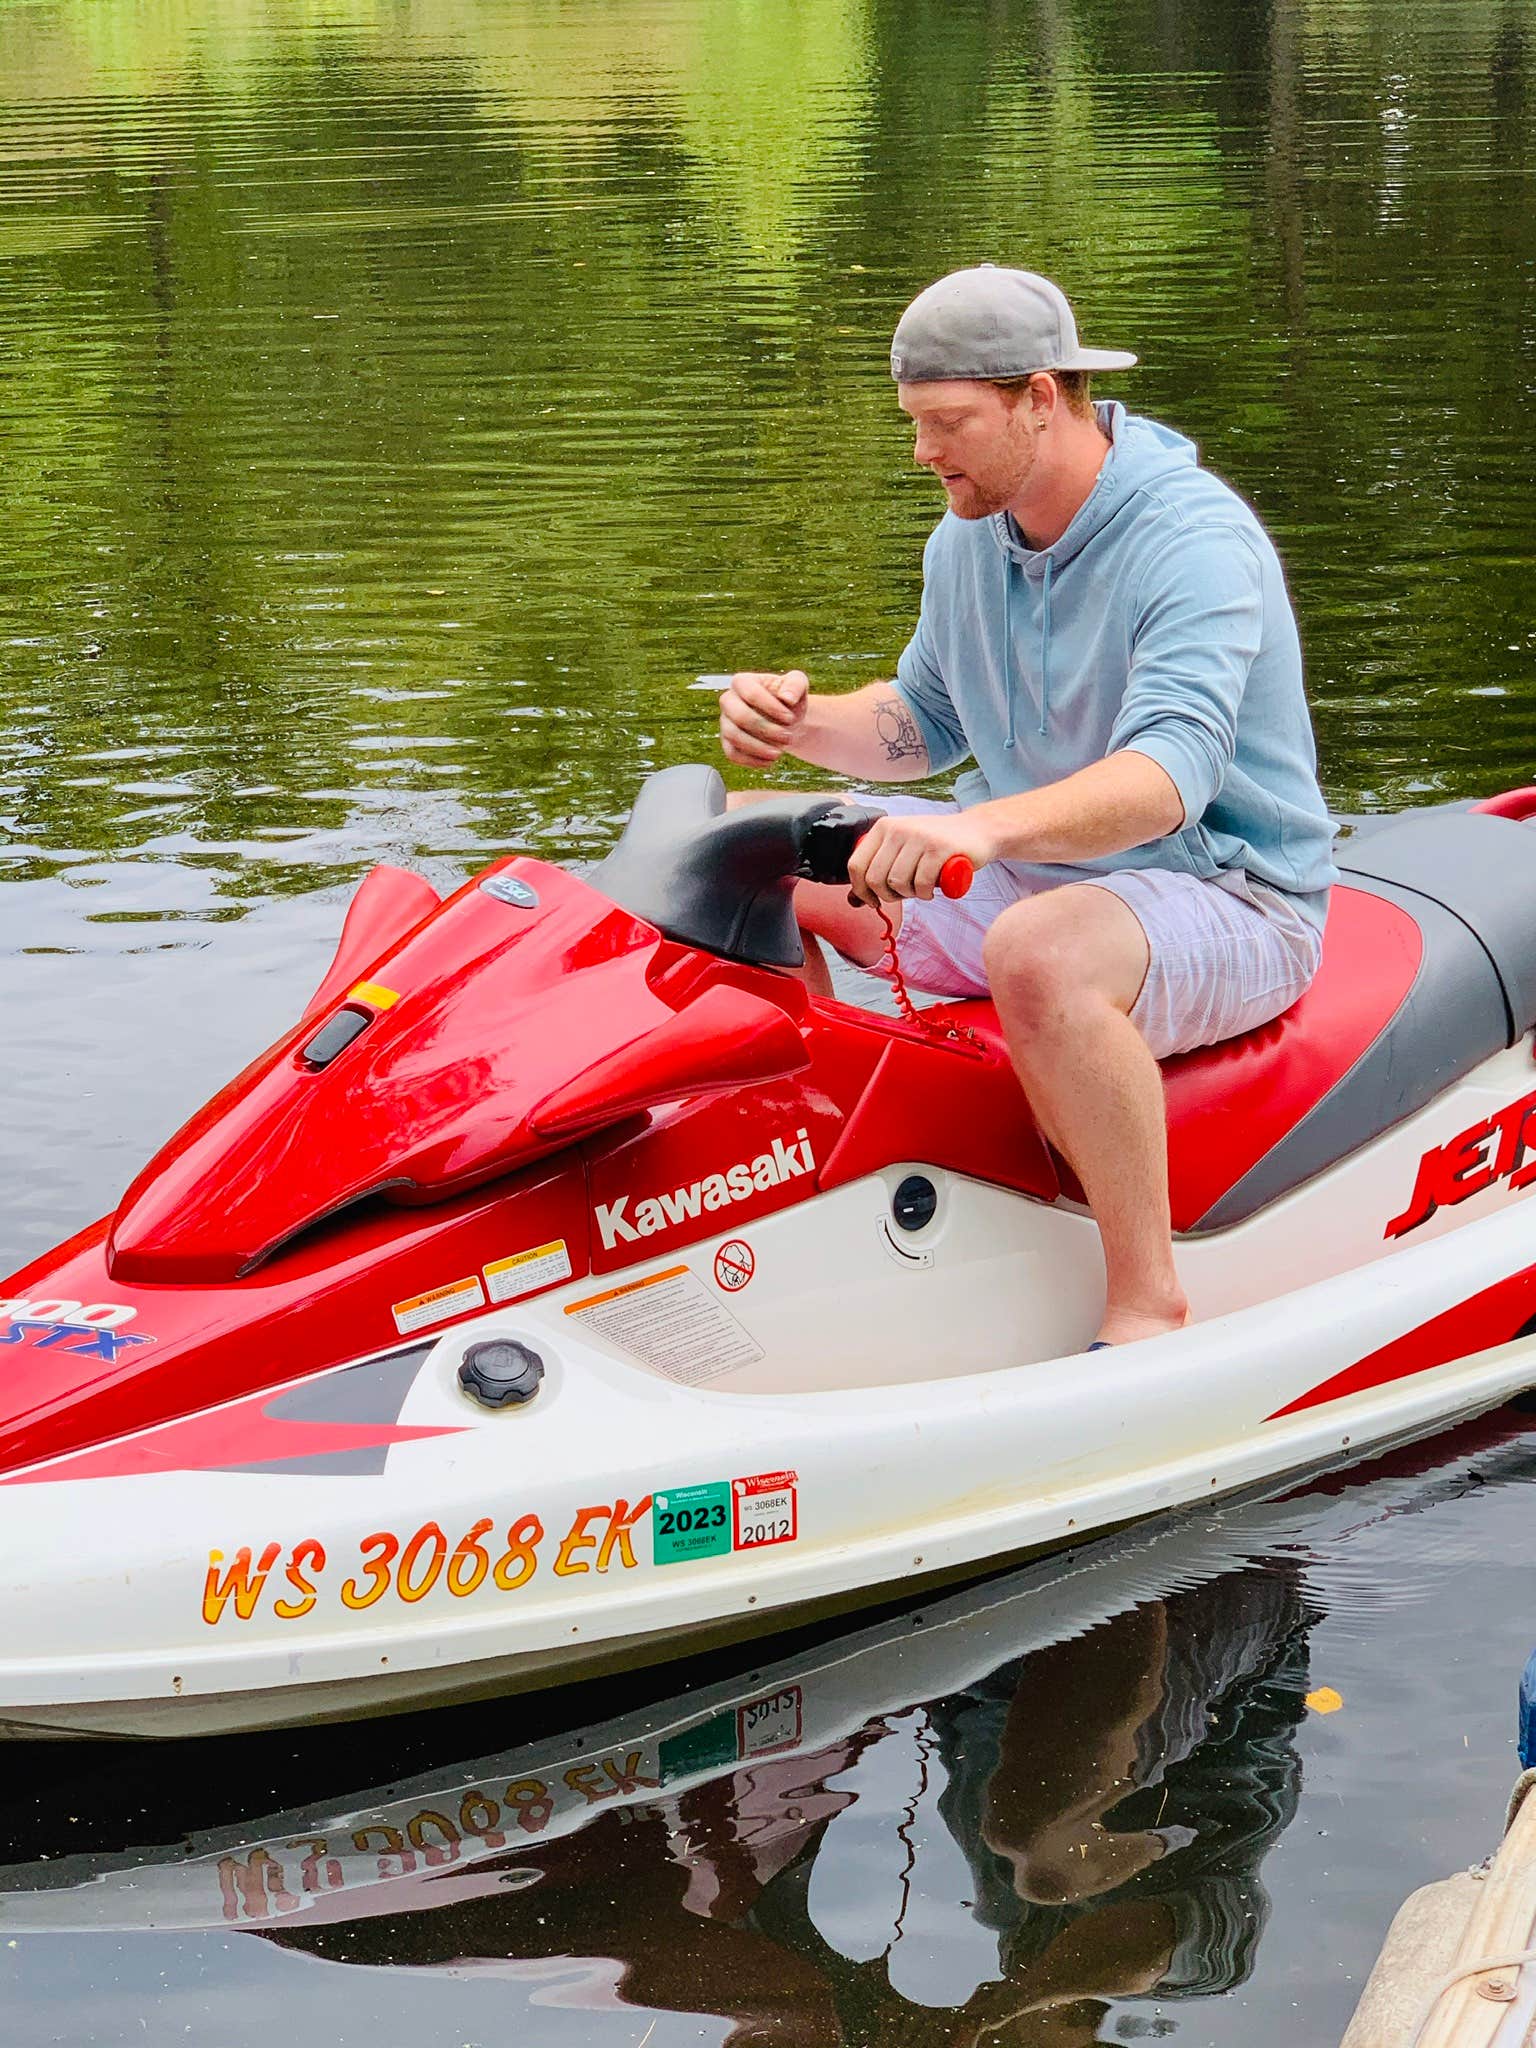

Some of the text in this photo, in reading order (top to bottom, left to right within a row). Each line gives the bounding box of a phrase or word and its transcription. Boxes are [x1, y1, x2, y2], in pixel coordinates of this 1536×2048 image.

[595, 1128, 815, 1250] Kawasaki
[512, 1251, 538, 1266] CAUTION
[426, 1287, 456, 1304] WARNING
[0, 1320, 157, 1364] STX
[745, 1471, 796, 1488] Wisconsin
[674, 1489, 709, 1500] Wisconsin
[754, 1496, 788, 1511] 3068EK
[658, 1504, 727, 1536] 2023
[743, 1519, 790, 1545] 2012
[672, 1538, 686, 1549] WS
[687, 1535, 717, 1547] 3068EK
[202, 1494, 655, 1626] WS 3068 EK
